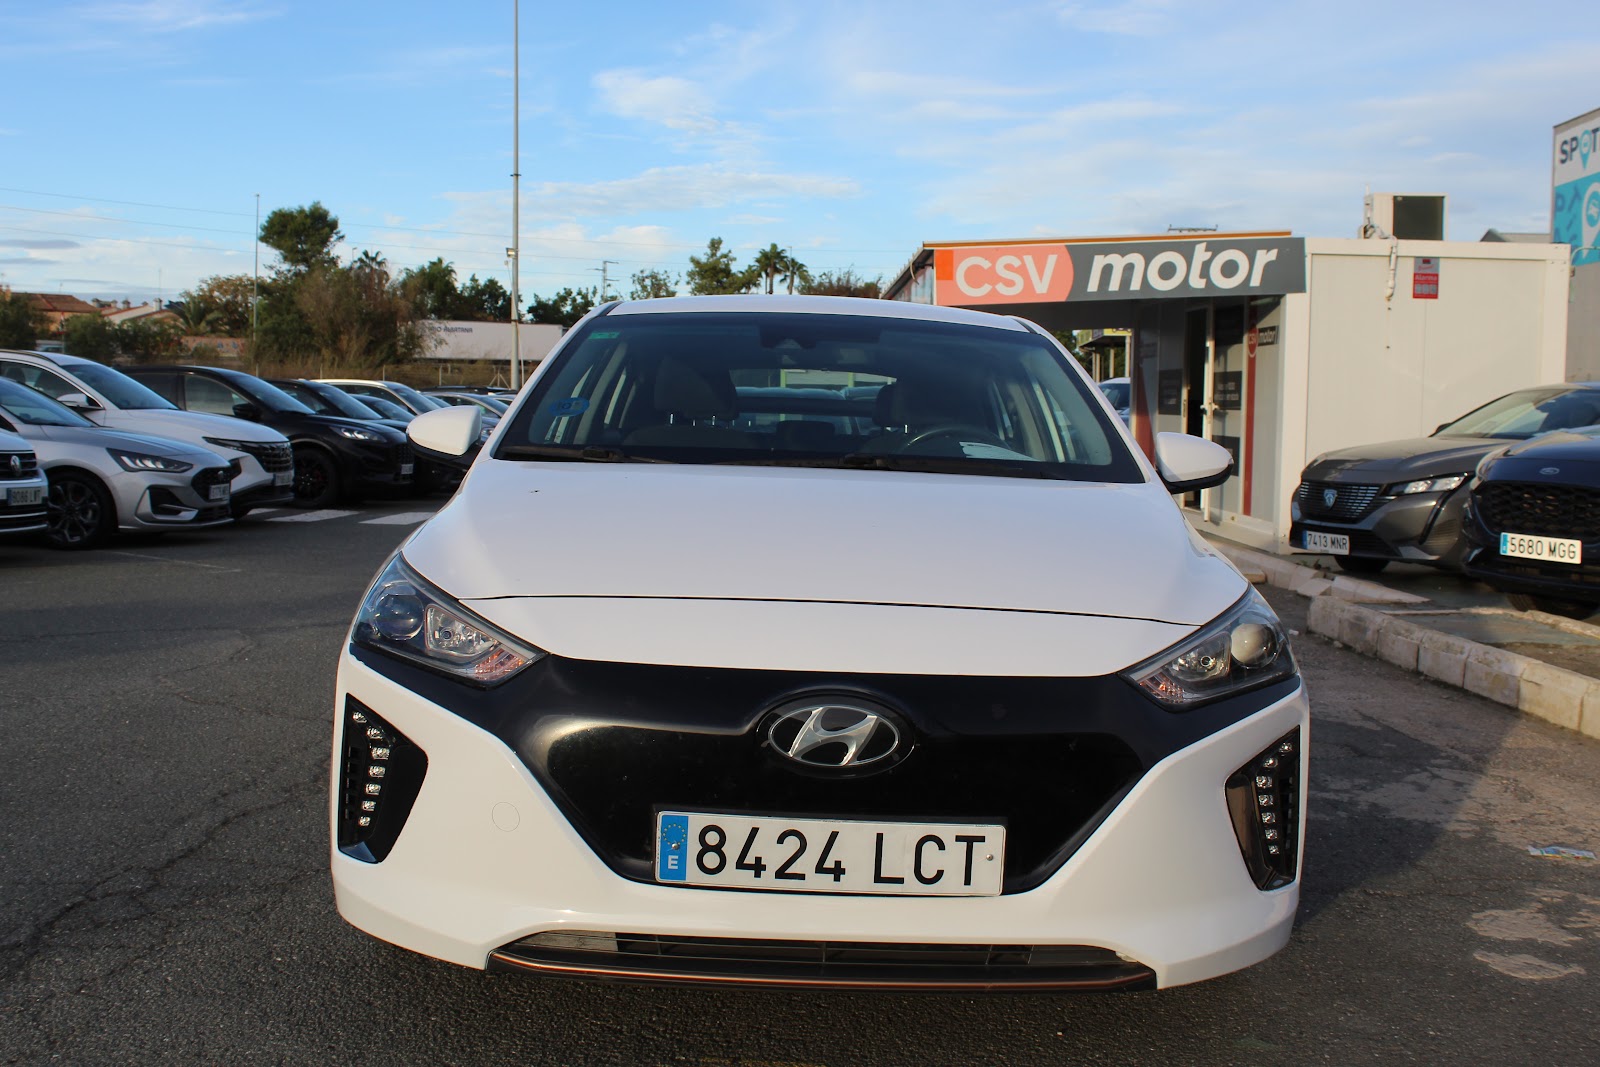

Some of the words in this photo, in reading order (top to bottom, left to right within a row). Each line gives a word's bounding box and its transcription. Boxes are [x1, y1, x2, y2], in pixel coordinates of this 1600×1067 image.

[1087, 241, 1279, 293] motor
[1308, 533, 1328, 548] 7413
[1330, 536, 1348, 550] MNR
[1510, 537, 1543, 556] 5680
[1549, 541, 1576, 559] MGG
[667, 855, 679, 870] E
[696, 824, 846, 882] 8424
[873, 832, 986, 886] LCT
